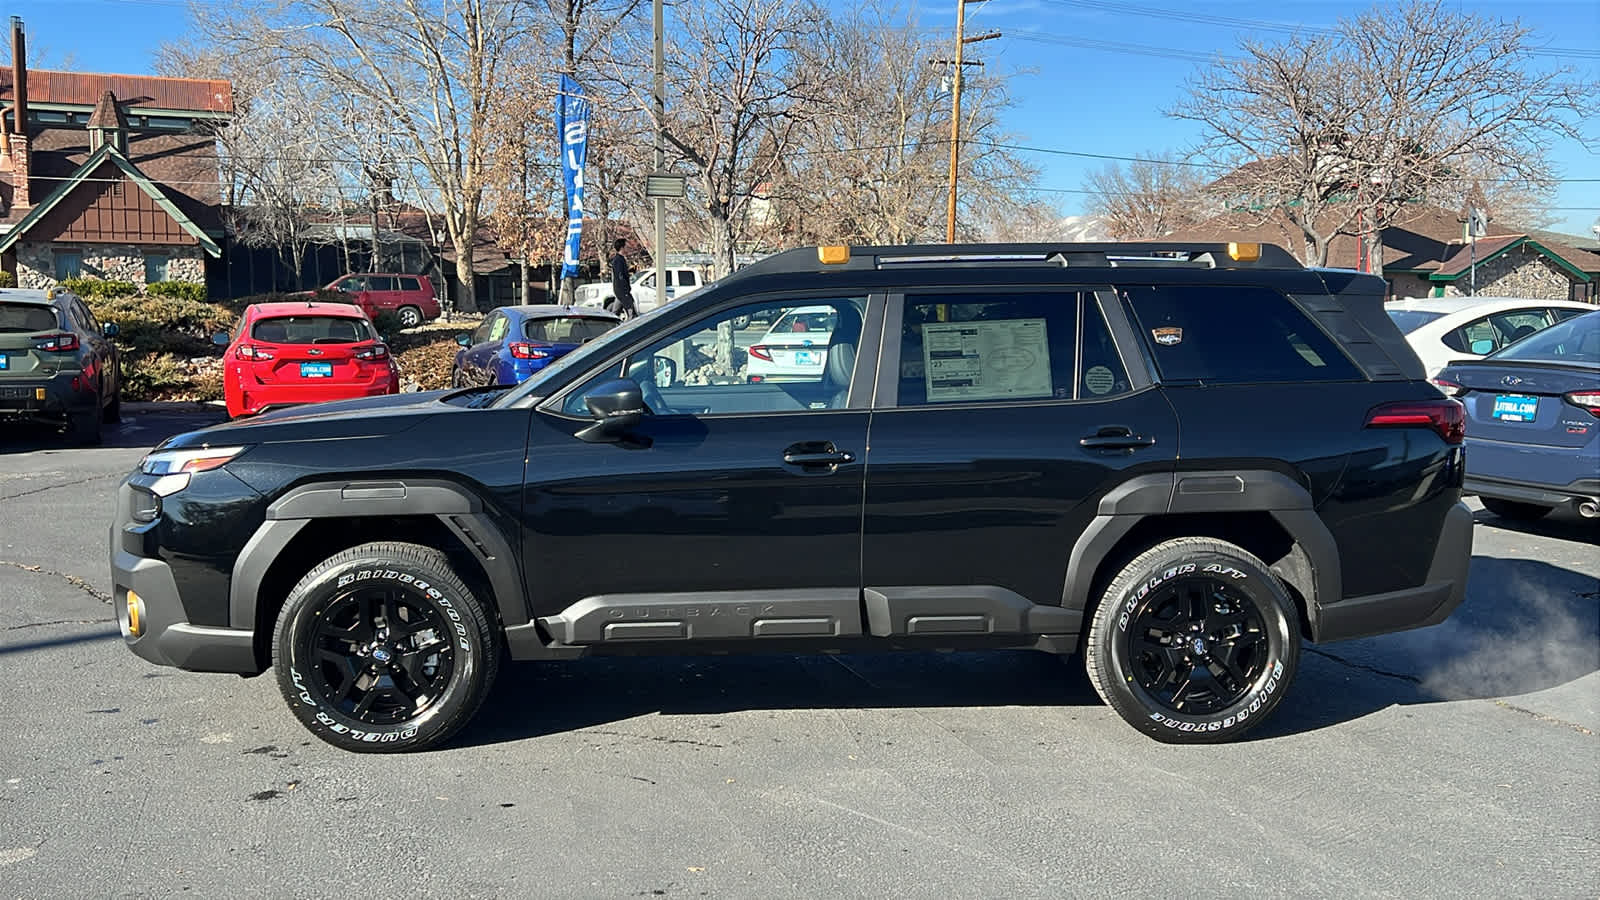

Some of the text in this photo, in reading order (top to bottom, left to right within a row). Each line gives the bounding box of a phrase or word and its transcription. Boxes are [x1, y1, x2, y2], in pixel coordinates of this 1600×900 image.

[337, 568, 471, 653] BRIDGESTONE
[608, 604, 776, 619] OUTBACK
[1118, 562, 1248, 633] DUELER A/T
[290, 666, 420, 743] DUELER A/T
[1149, 658, 1284, 733] BRIDGESTONE
